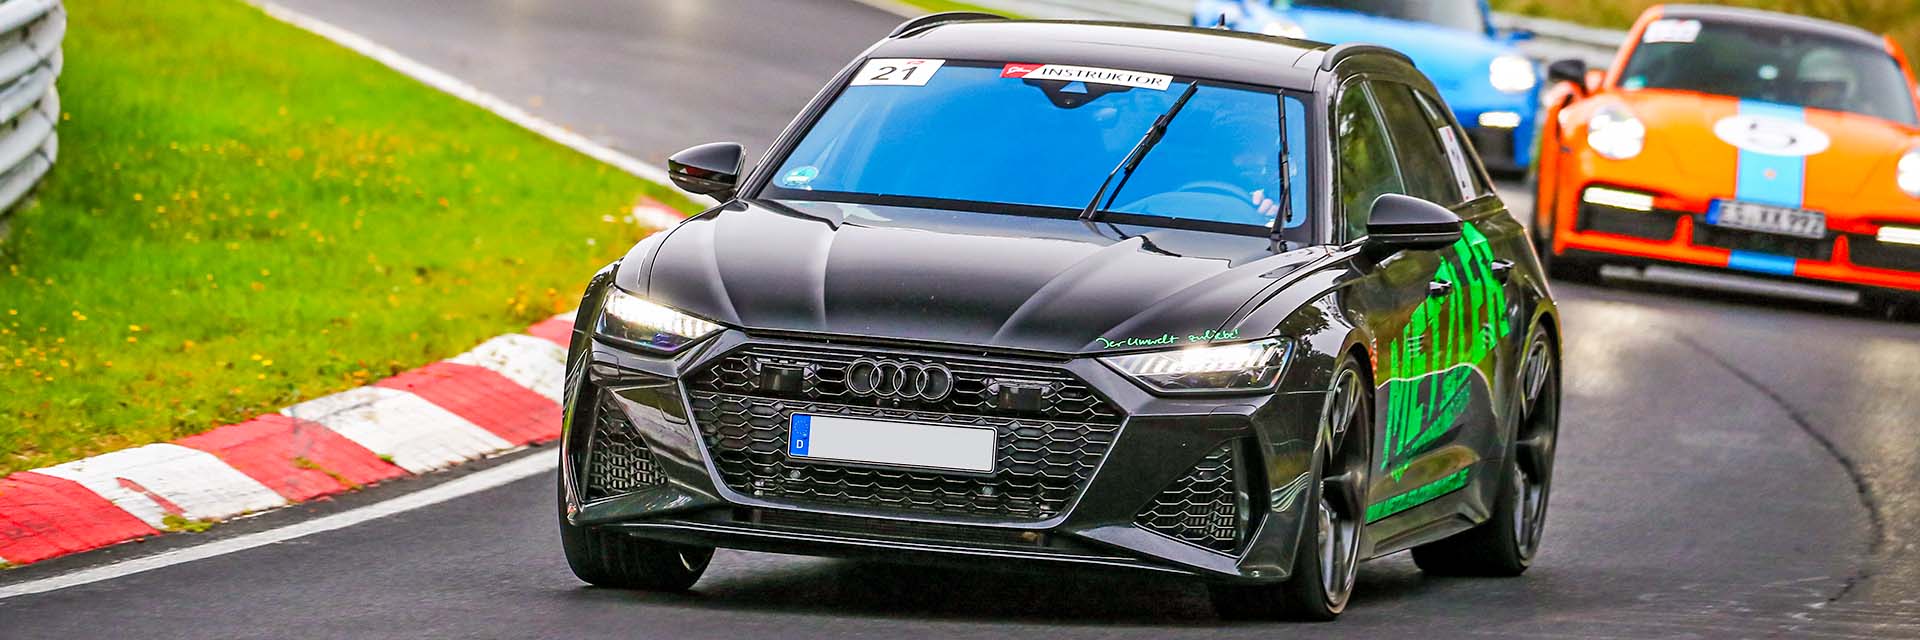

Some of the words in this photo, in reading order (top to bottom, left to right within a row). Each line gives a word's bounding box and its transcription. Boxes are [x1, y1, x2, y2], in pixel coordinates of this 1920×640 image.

[870, 66, 918, 81] 21
[1041, 67, 1164, 86] INSTRUKTOR
[1095, 337, 1127, 349] Der
[1127, 333, 1180, 347] Umwelt
[796, 439, 804, 449] D
